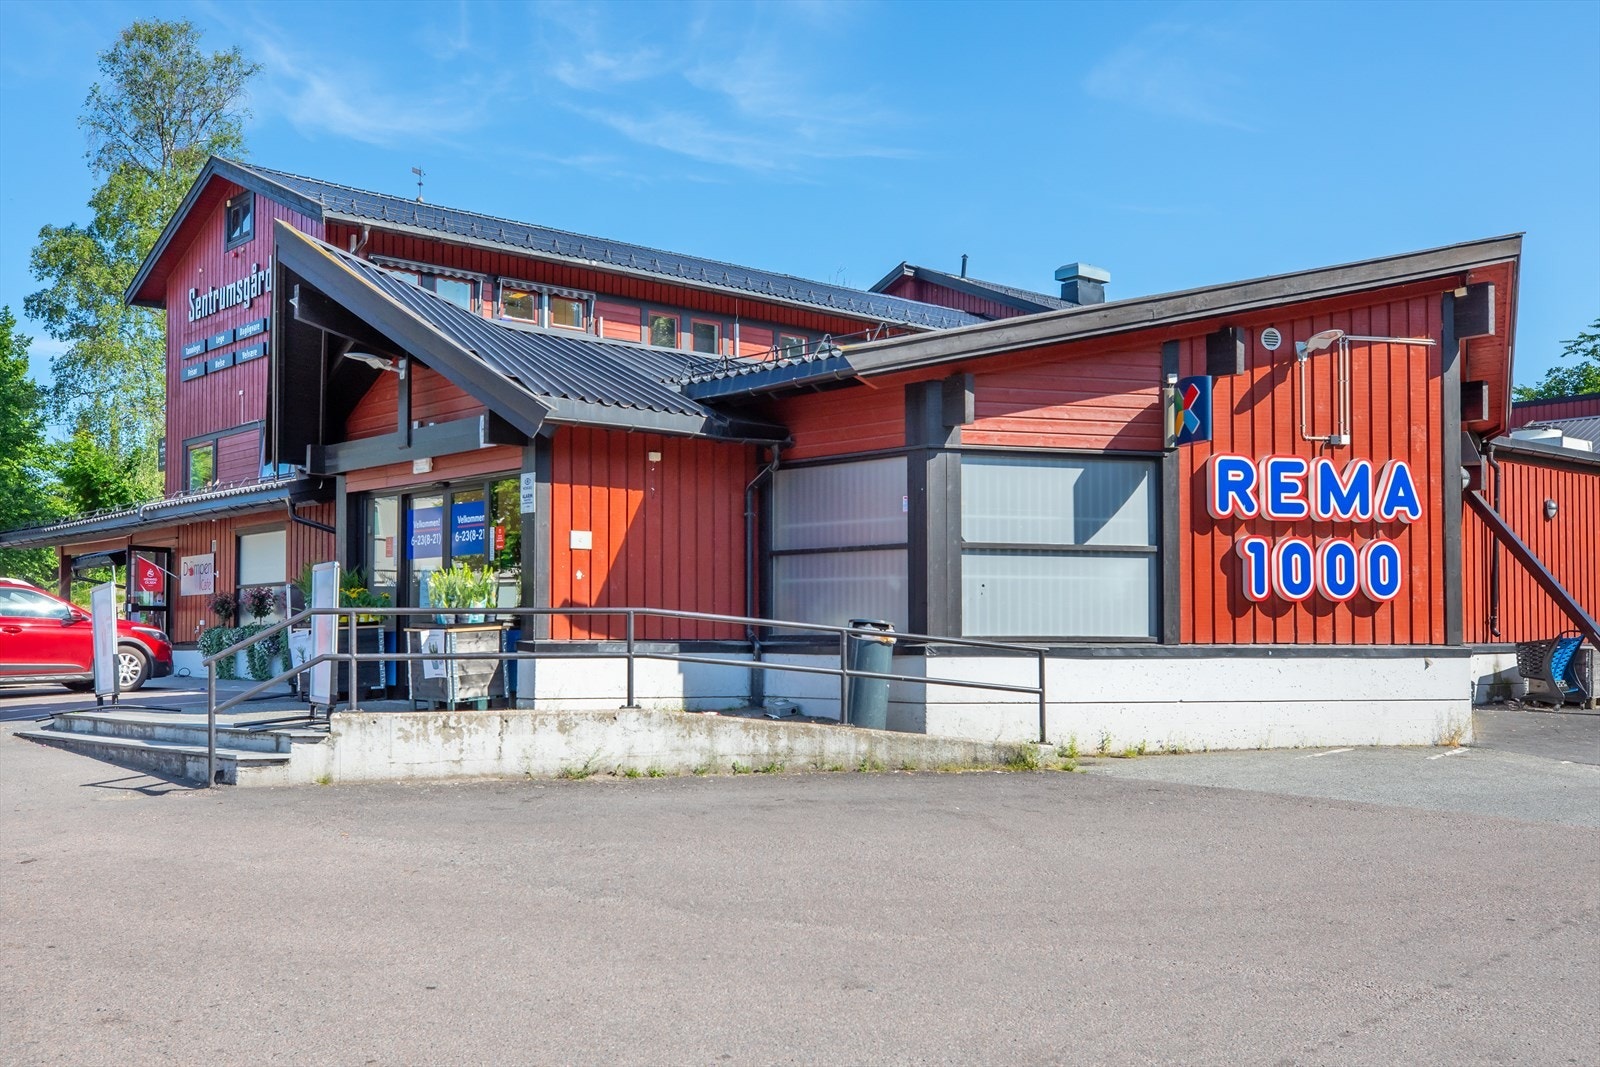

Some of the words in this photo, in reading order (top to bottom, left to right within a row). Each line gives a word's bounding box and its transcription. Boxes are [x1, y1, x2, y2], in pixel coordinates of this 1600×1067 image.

[188, 254, 272, 322] Sentrumsgård
[1212, 454, 1422, 521] REMA
[1242, 536, 1401, 601] 1000
